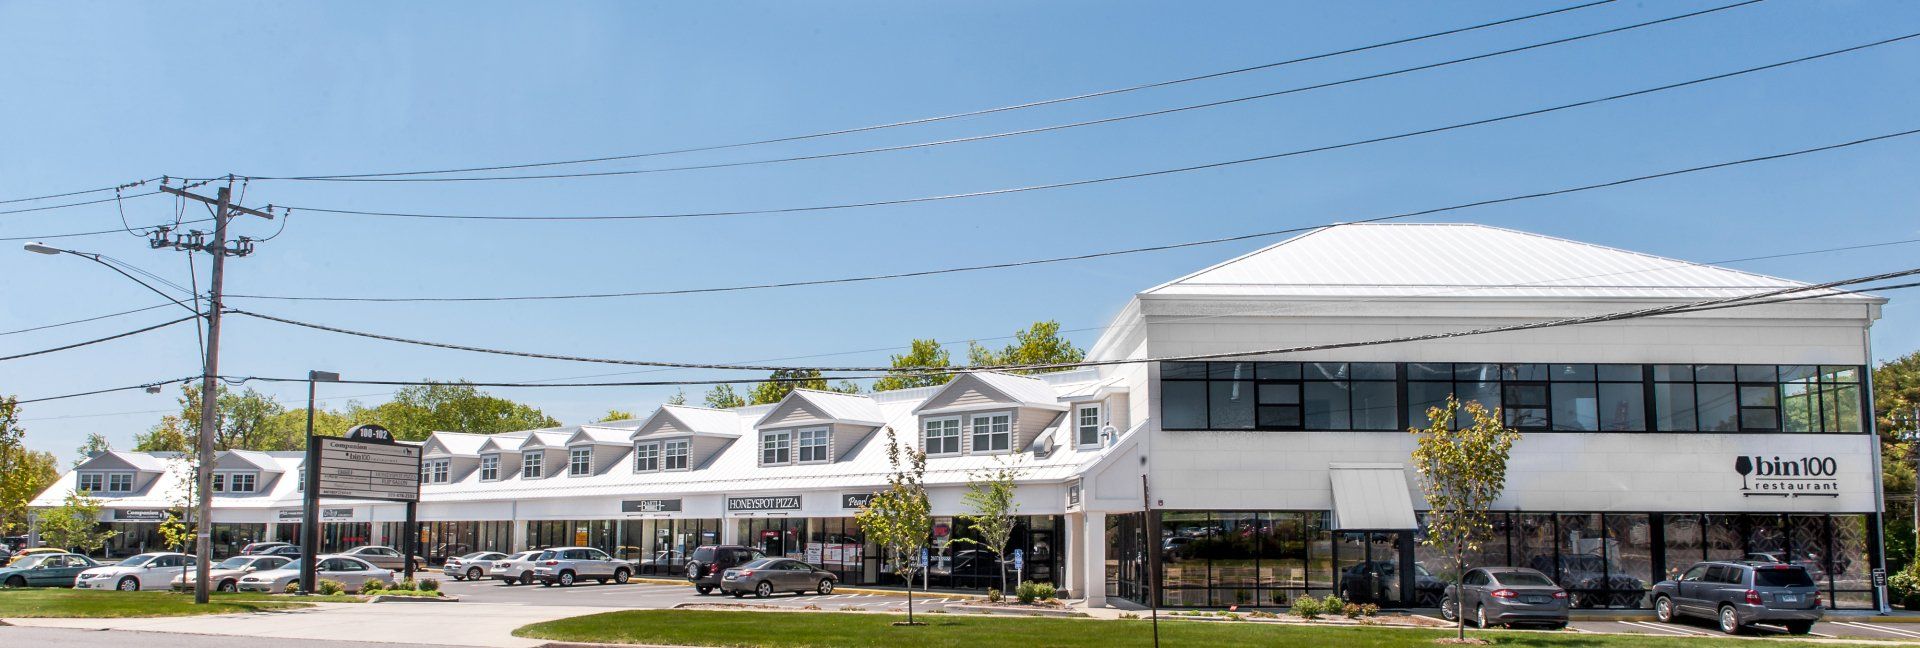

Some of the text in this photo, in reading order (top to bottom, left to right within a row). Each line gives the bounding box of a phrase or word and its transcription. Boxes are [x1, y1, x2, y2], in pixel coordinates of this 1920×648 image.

[360, 428, 388, 440] 100-102
[330, 441, 368, 451] Companion
[1755, 456, 1837, 476] bin100
[1755, 482, 1838, 490] restaurant
[730, 497, 800, 509] HONEYSPOT PIZZA
